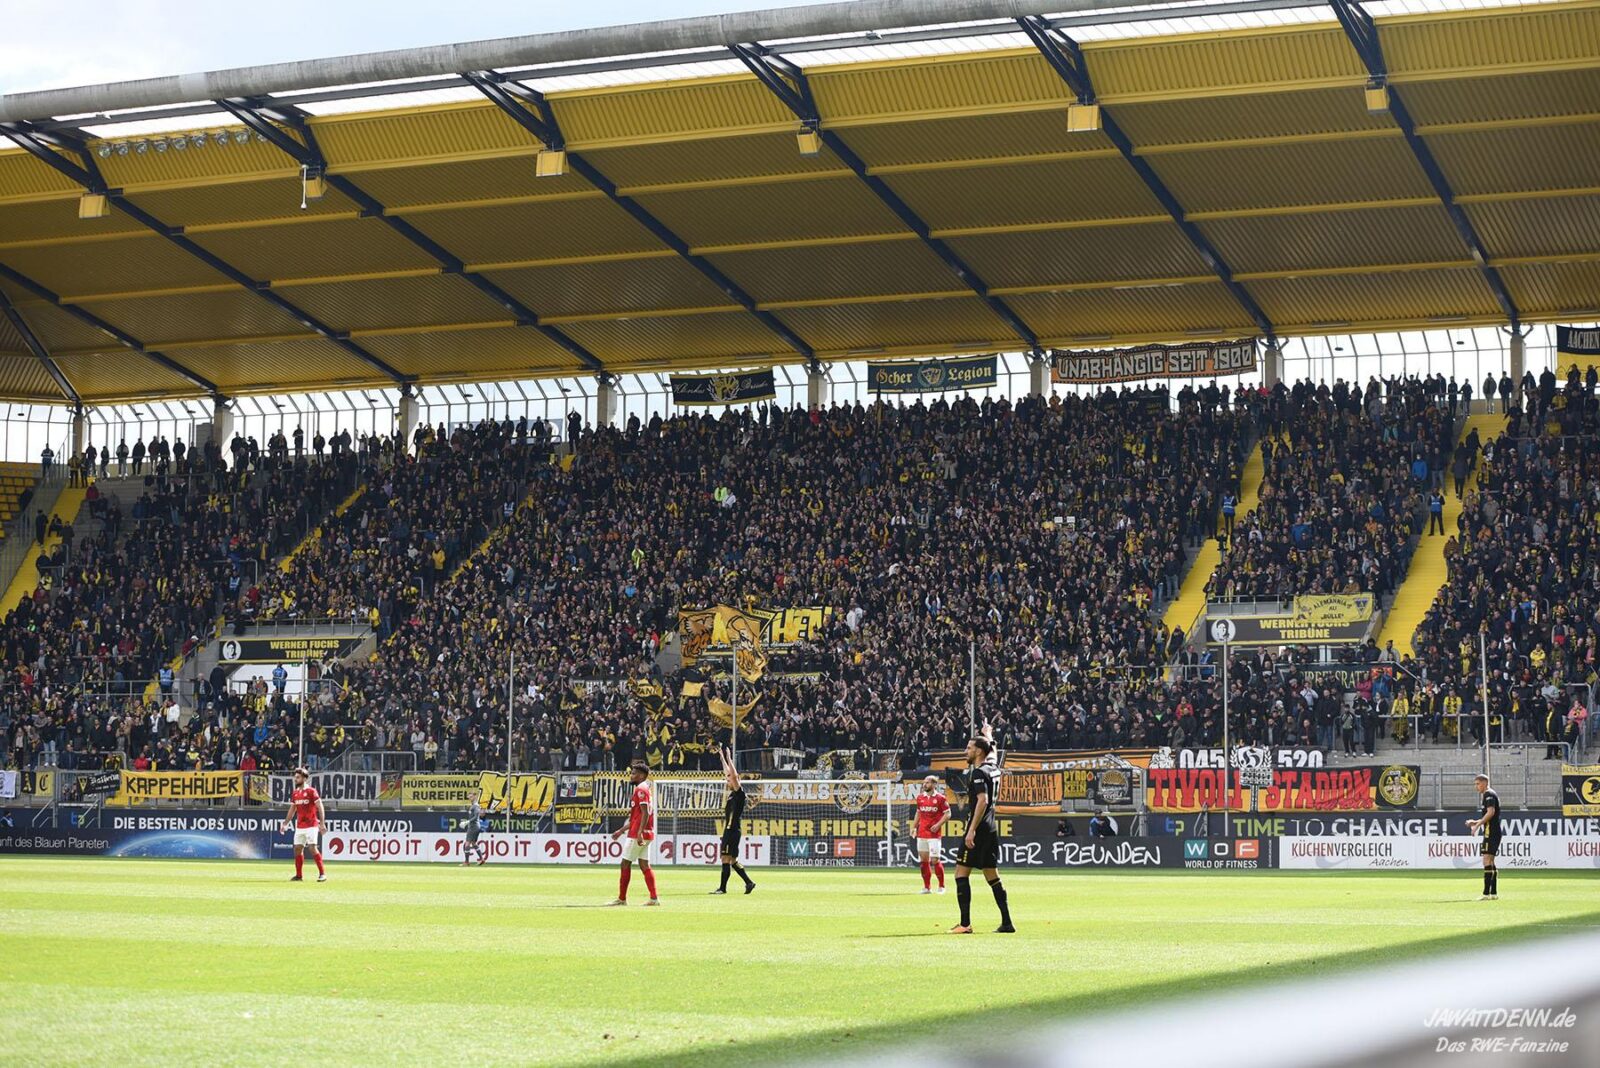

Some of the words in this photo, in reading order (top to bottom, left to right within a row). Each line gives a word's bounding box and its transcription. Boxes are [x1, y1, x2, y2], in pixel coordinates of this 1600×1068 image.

[1168, 350, 1208, 373] SEIT
[1212, 345, 1251, 370] 1900
[948, 365, 992, 384] Legion
[1279, 628, 1331, 639] TRIBÜNE
[270, 641, 308, 650] WERNER
[309, 640, 340, 649] FUCHS
[126, 773, 240, 795] KAPPEHÄUER
[311, 774, 377, 801] AACHEN
[763, 783, 830, 800] KARLS
[877, 784, 946, 800] BANE
[1150, 769, 1244, 809] TIVOLI
[1264, 767, 1374, 809] STADION
[114, 817, 135, 830] DIE
[138, 817, 186, 830] BESTEN
[189, 818, 225, 831] JOBS
[228, 819, 257, 831] UND
[261, 818, 350, 832] MITATER
[353, 819, 413, 833] (M/W/D)
[1233, 819, 1286, 836] TIME
[1331, 818, 1448, 836] CHANGE!
[15, 837, 33, 848] des
[34, 837, 66, 848] Blauen
[68, 837, 111, 849] Planeten.
[349, 834, 400, 860] regio
[566, 836, 623, 863] regio
[1291, 840, 1392, 857] KÜCHENVERGLEICH
[1428, 840, 1531, 857] KÜCHENVEGLEICH
[1567, 839, 1600, 857] KÜCH
[1052, 841, 1161, 865] FREUNDEN
[788, 858, 814, 867] WORLD
[825, 858, 855, 867] FITNESS
[1185, 860, 1212, 868] WORLD
[1214, 860, 1223, 868] OF
[1225, 860, 1258, 868] FITNESS
[1369, 857, 1410, 867] Aachen
[1508, 857, 1548, 867] Aachen
